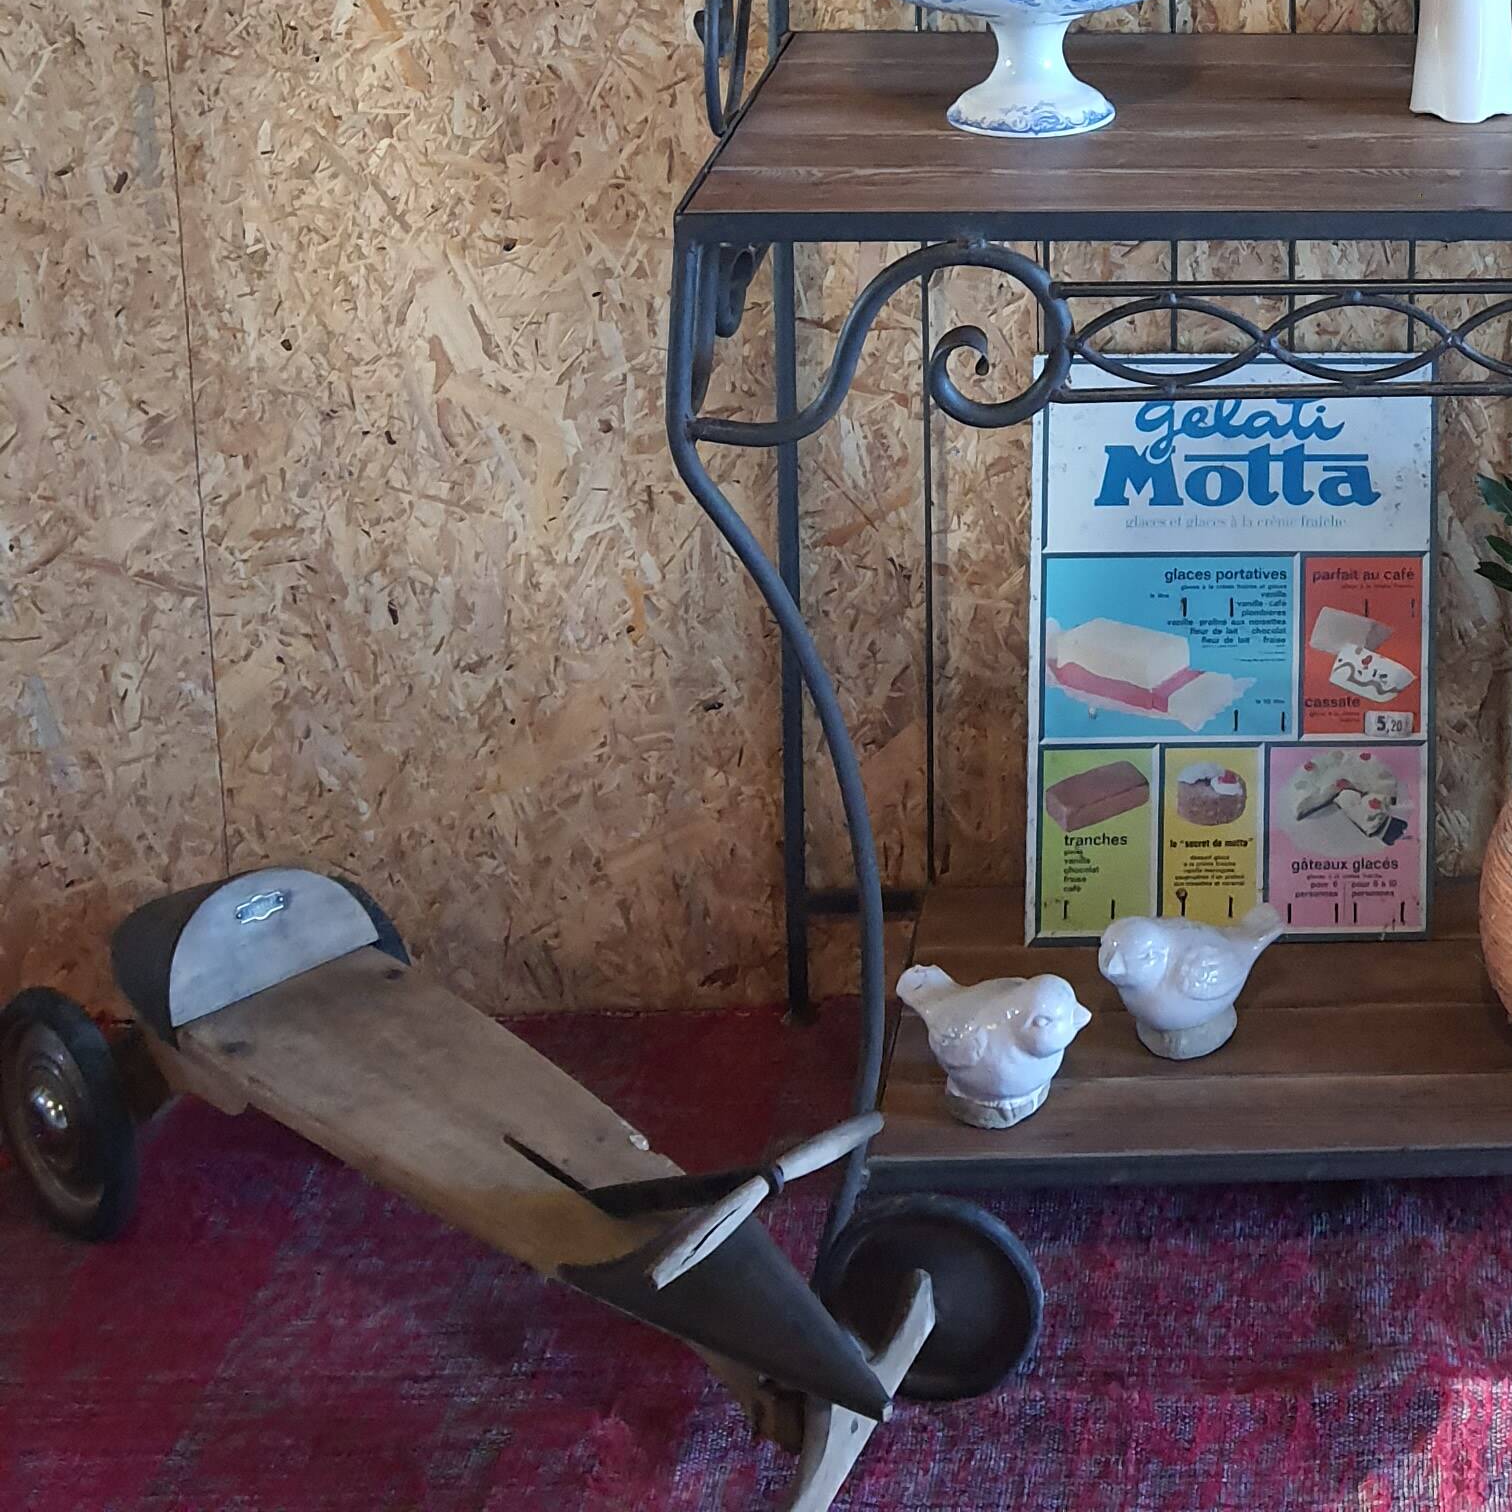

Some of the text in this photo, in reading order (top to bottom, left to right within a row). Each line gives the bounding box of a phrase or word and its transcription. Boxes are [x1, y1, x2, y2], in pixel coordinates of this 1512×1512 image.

[1135, 399, 1345, 461] gelati
[1094, 443, 1382, 507] Motta
[1125, 515, 1167, 529] glaces
[1169, 515, 1182, 527] et
[1185, 515, 1226, 529] glaces
[1164, 568, 1288, 584] glaces portatives
[1312, 567, 1415, 584] parfait au café
[1251, 627, 1287, 635] chocolat
[1304, 696, 1361, 708] cassate
[1376, 715, 1403, 734] 5,20
[1064, 833, 1128, 846] tranches
[1291, 857, 1399, 874] gâteaux glacés
